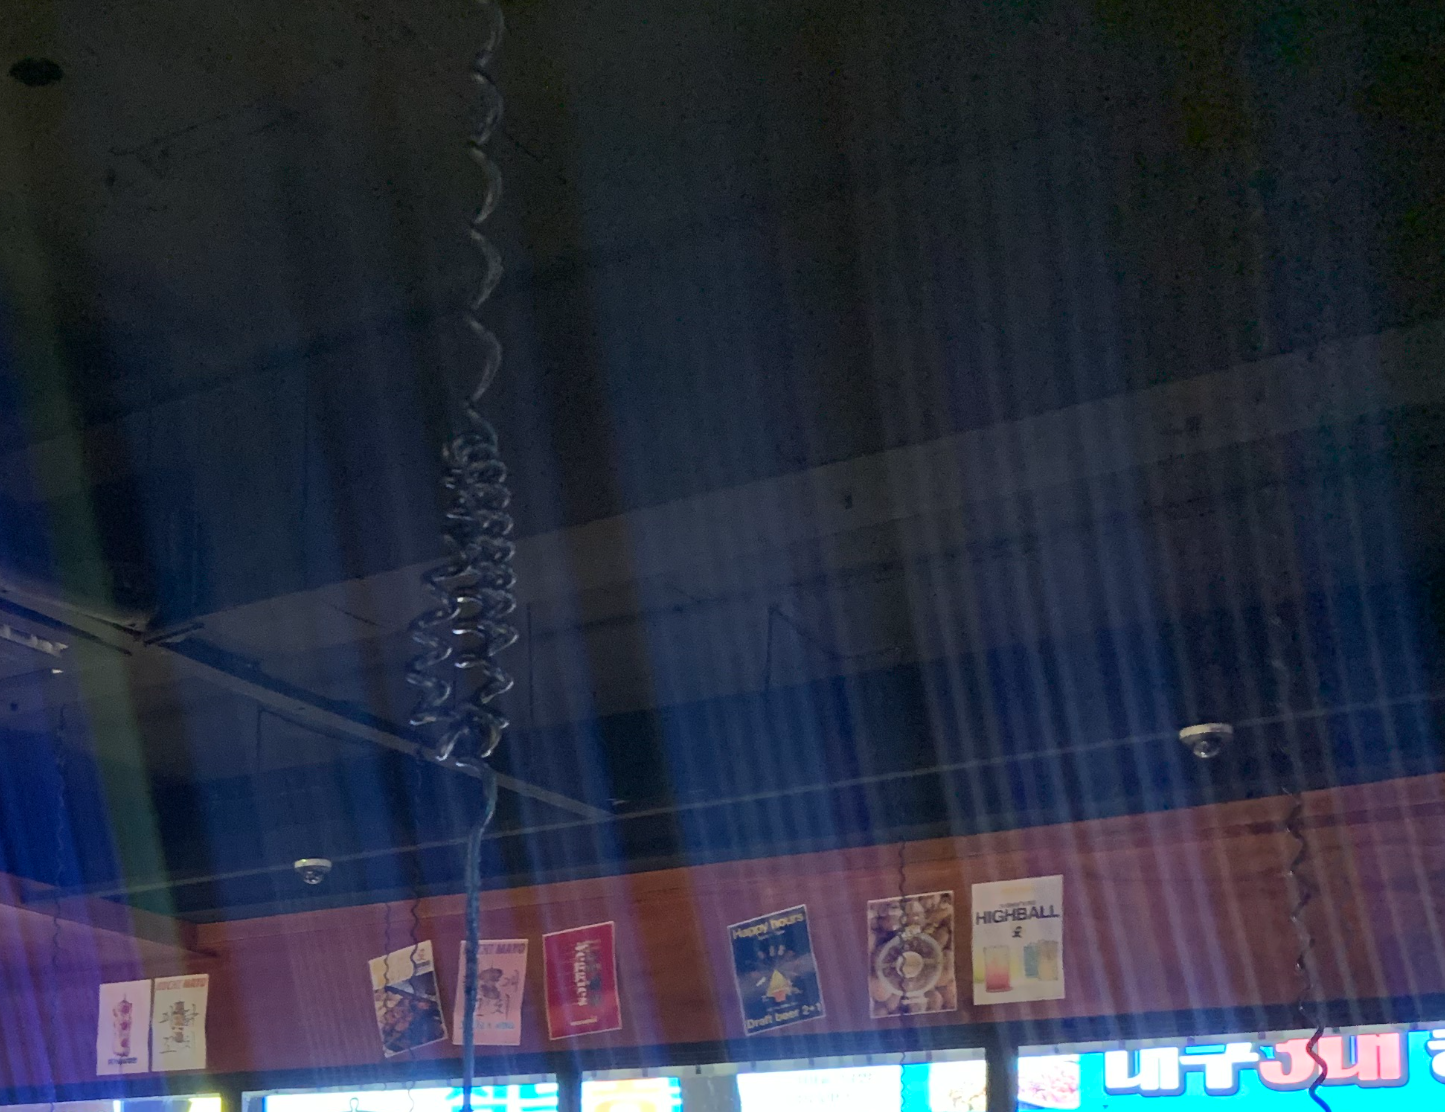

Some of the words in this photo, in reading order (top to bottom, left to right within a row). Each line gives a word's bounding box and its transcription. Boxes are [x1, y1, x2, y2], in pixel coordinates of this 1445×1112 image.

[975, 904, 1061, 925] HIGHBALL
[732, 921, 769, 940] Happy
[769, 912, 804, 930] hours
[747, 1014, 773, 1029] Draft
